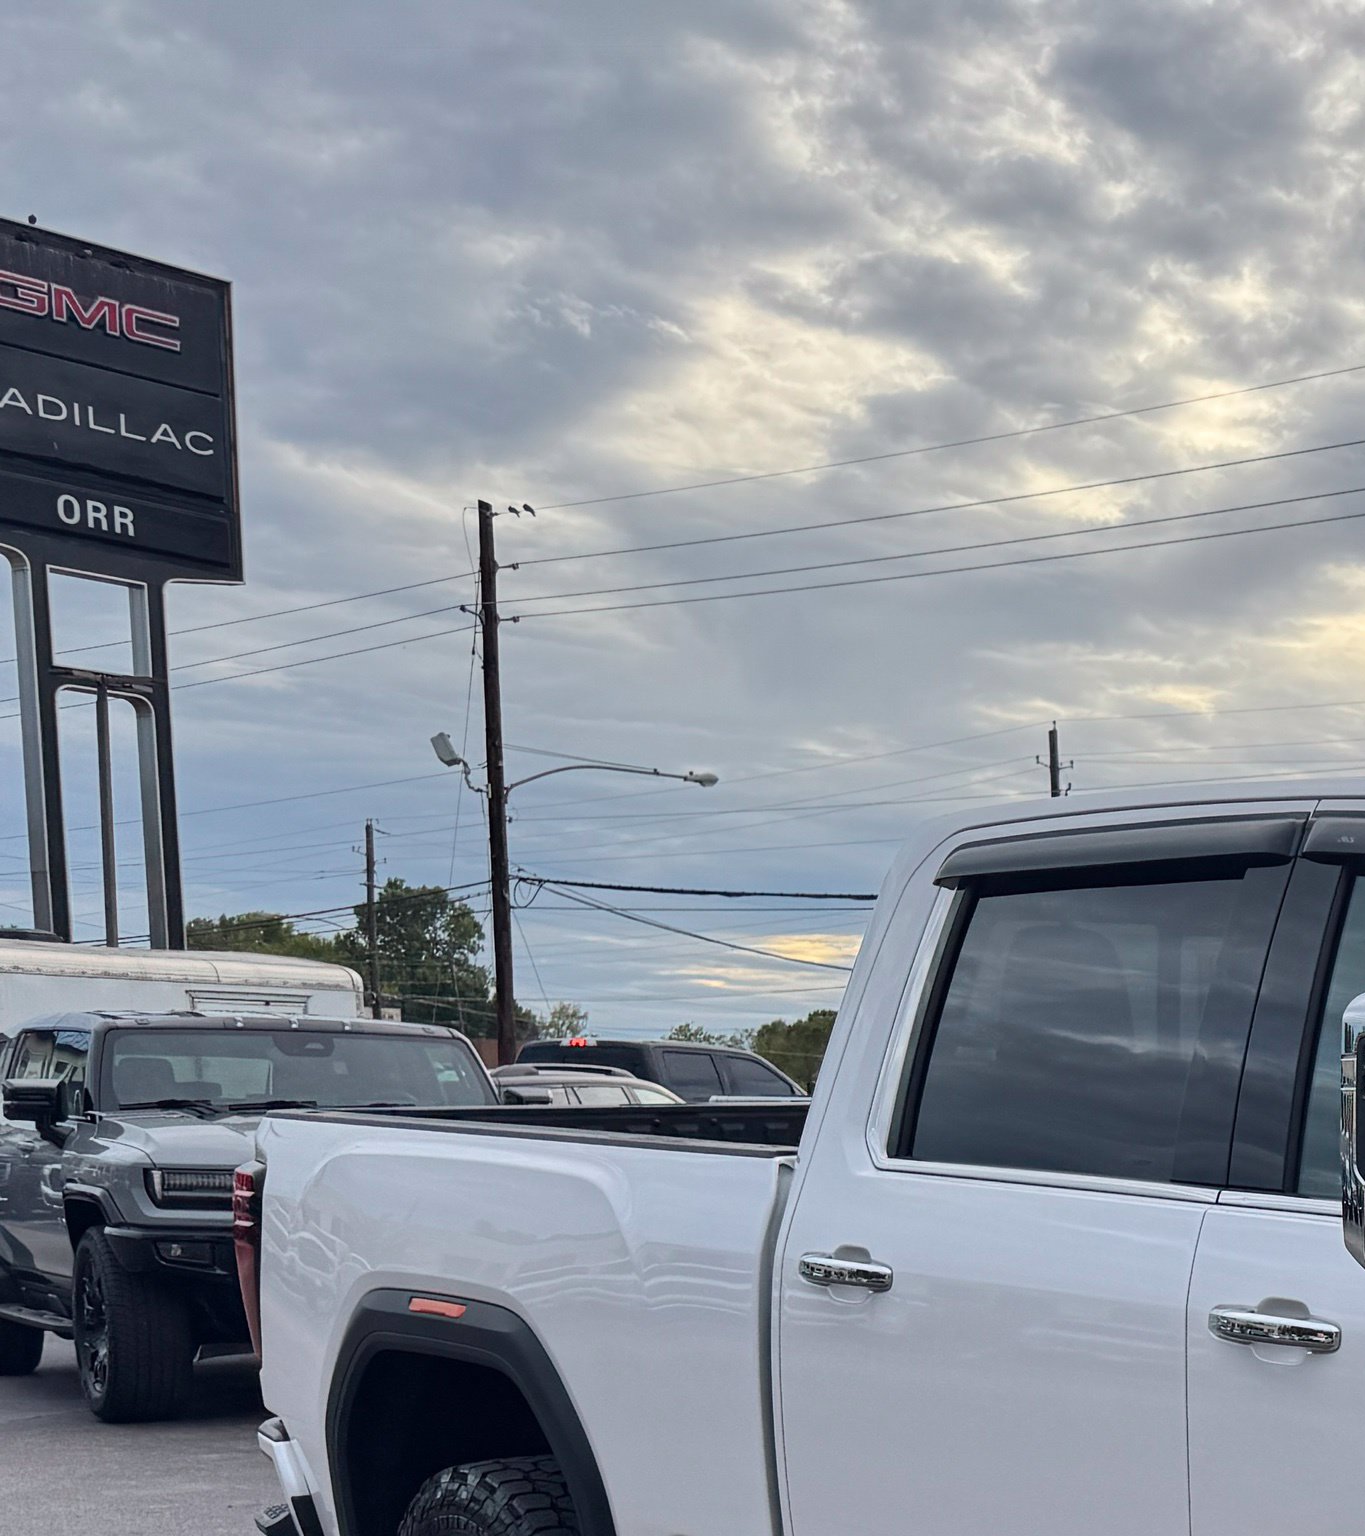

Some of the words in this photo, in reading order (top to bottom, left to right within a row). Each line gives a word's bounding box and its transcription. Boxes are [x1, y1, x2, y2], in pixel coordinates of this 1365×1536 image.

[0, 269, 181, 352] GMC
[0, 387, 215, 456] ADILLAC
[57, 494, 135, 537] ORR
